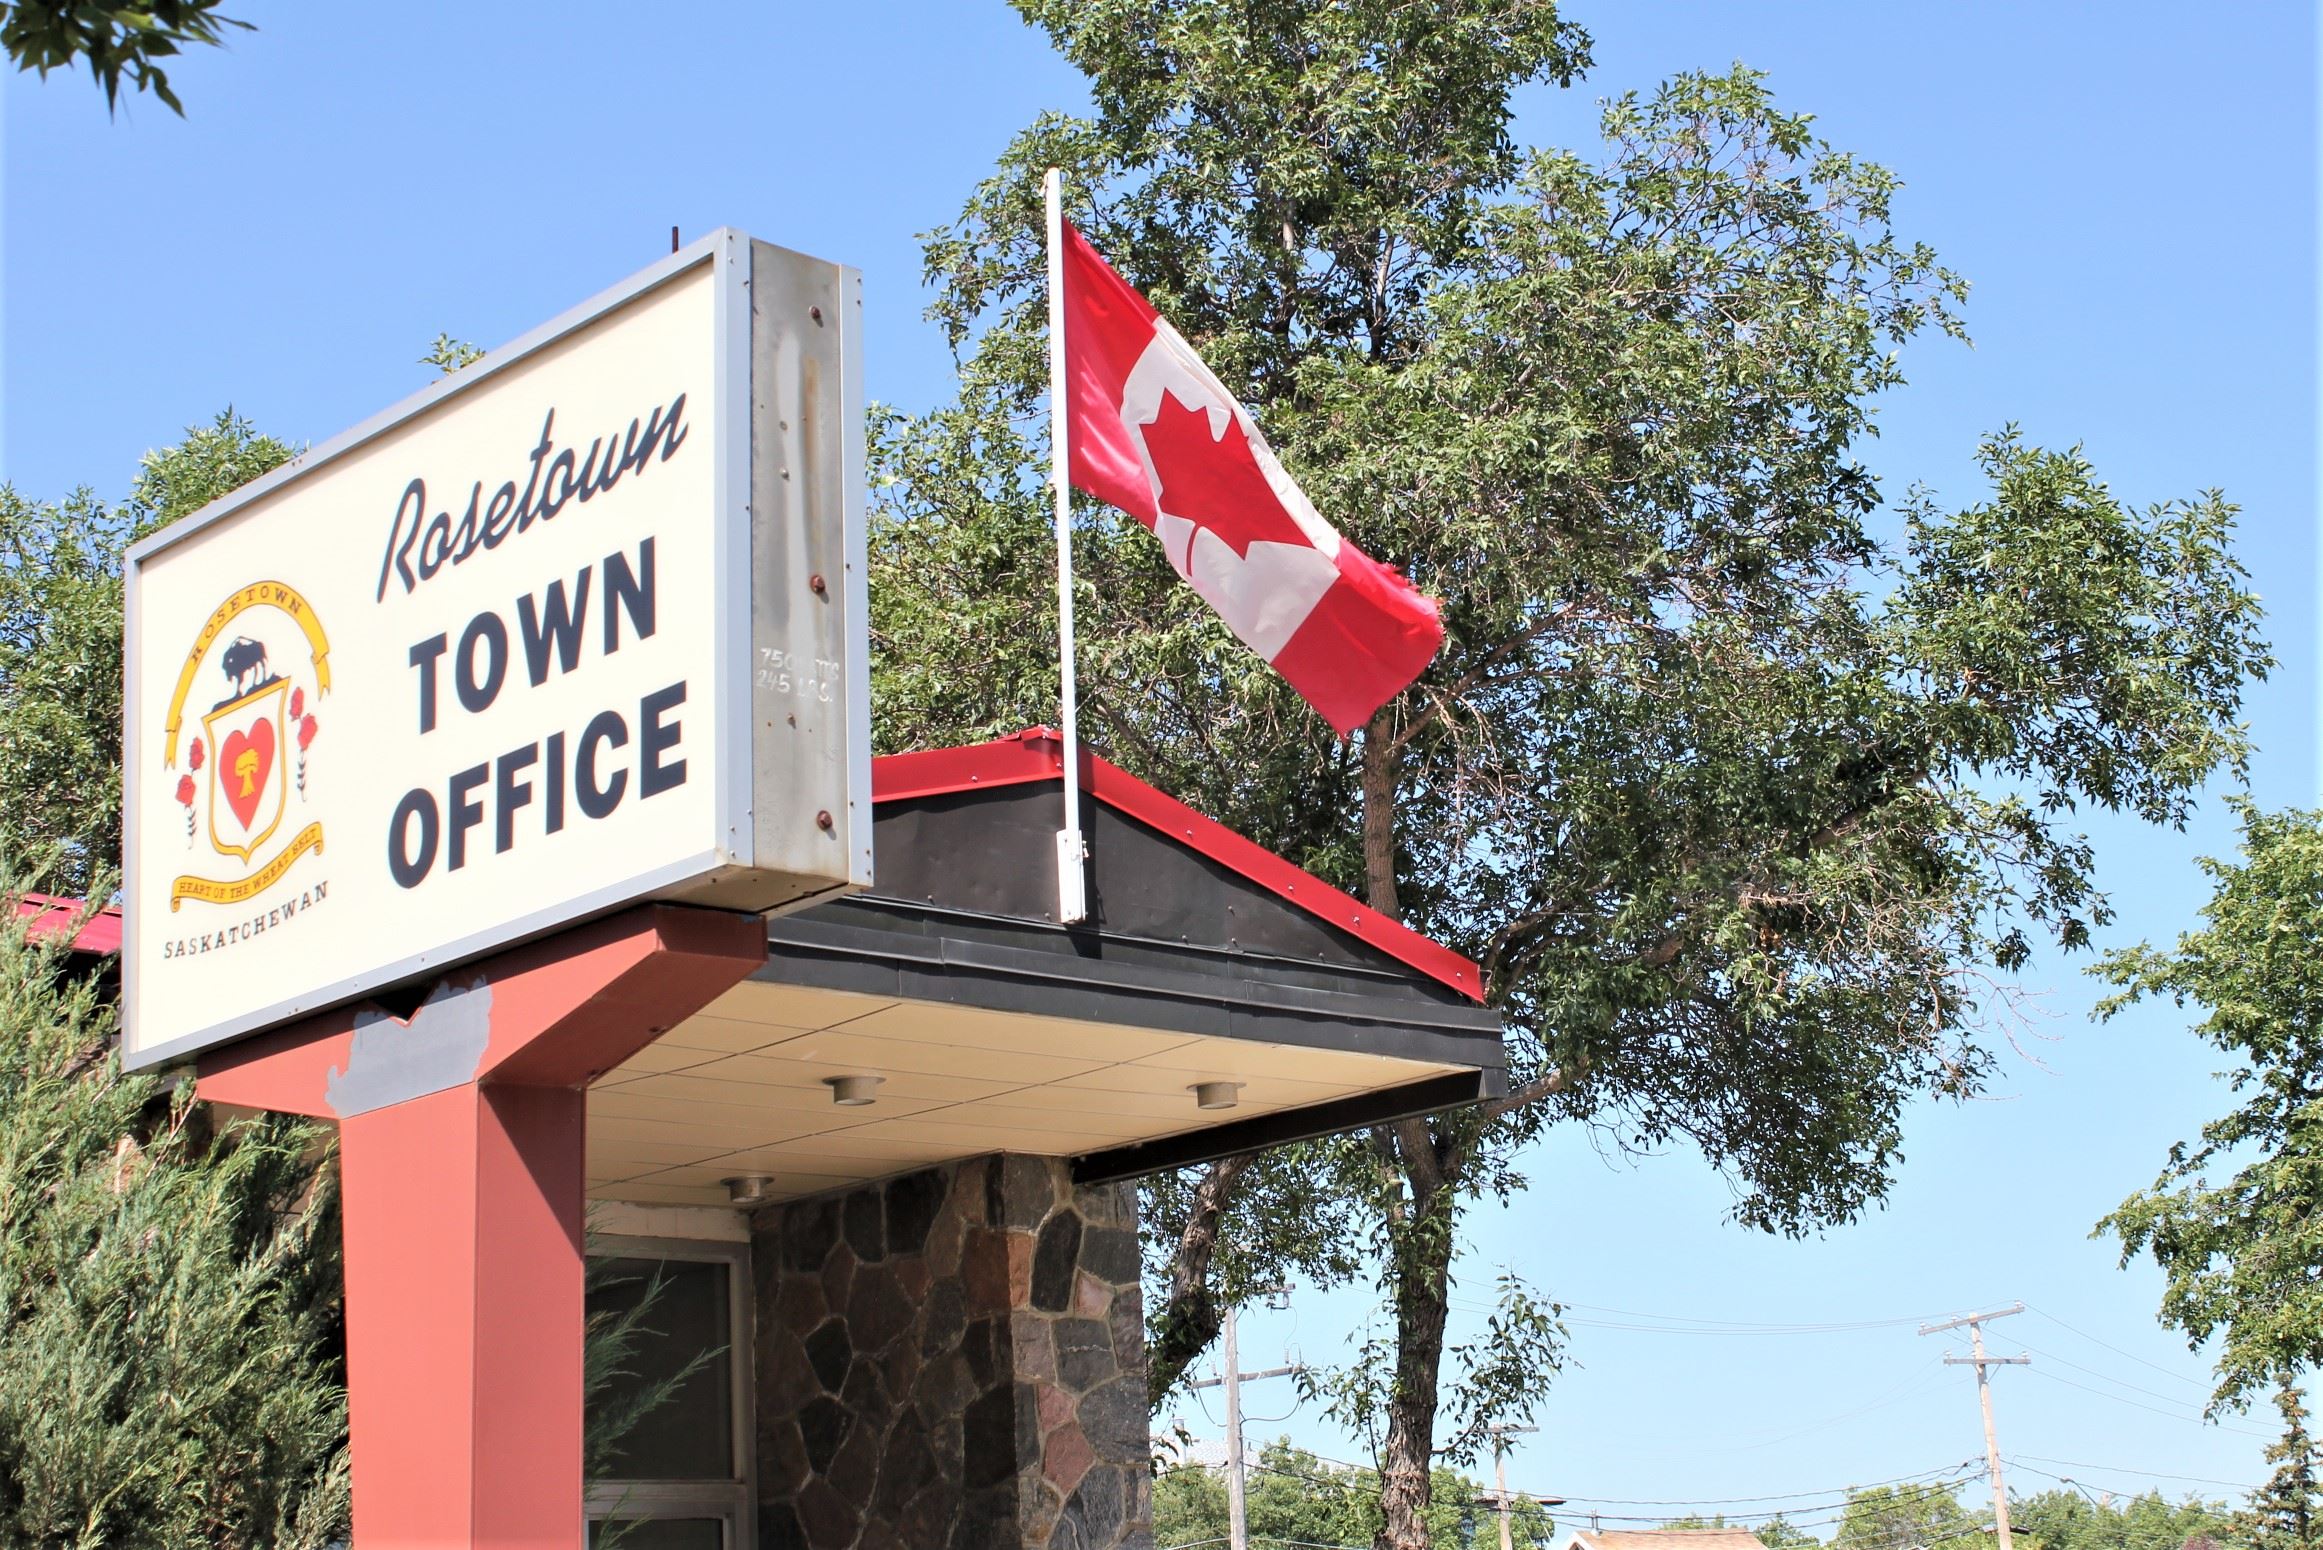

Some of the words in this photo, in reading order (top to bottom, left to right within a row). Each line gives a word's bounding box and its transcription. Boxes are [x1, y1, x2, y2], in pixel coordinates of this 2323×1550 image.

[377, 392, 689, 604] Rosetown
[190, 583, 303, 664] ROSETOWN
[409, 535, 656, 735] TOWN
[756, 668, 791, 694] 245
[388, 680, 687, 890] OFFICE
[178, 881, 211, 897] HEART
[213, 887, 227, 899] OF
[229, 884, 250, 899] THE
[252, 853, 290, 890] WHEAT
[164, 880, 329, 960] SASKATCHEWAN
